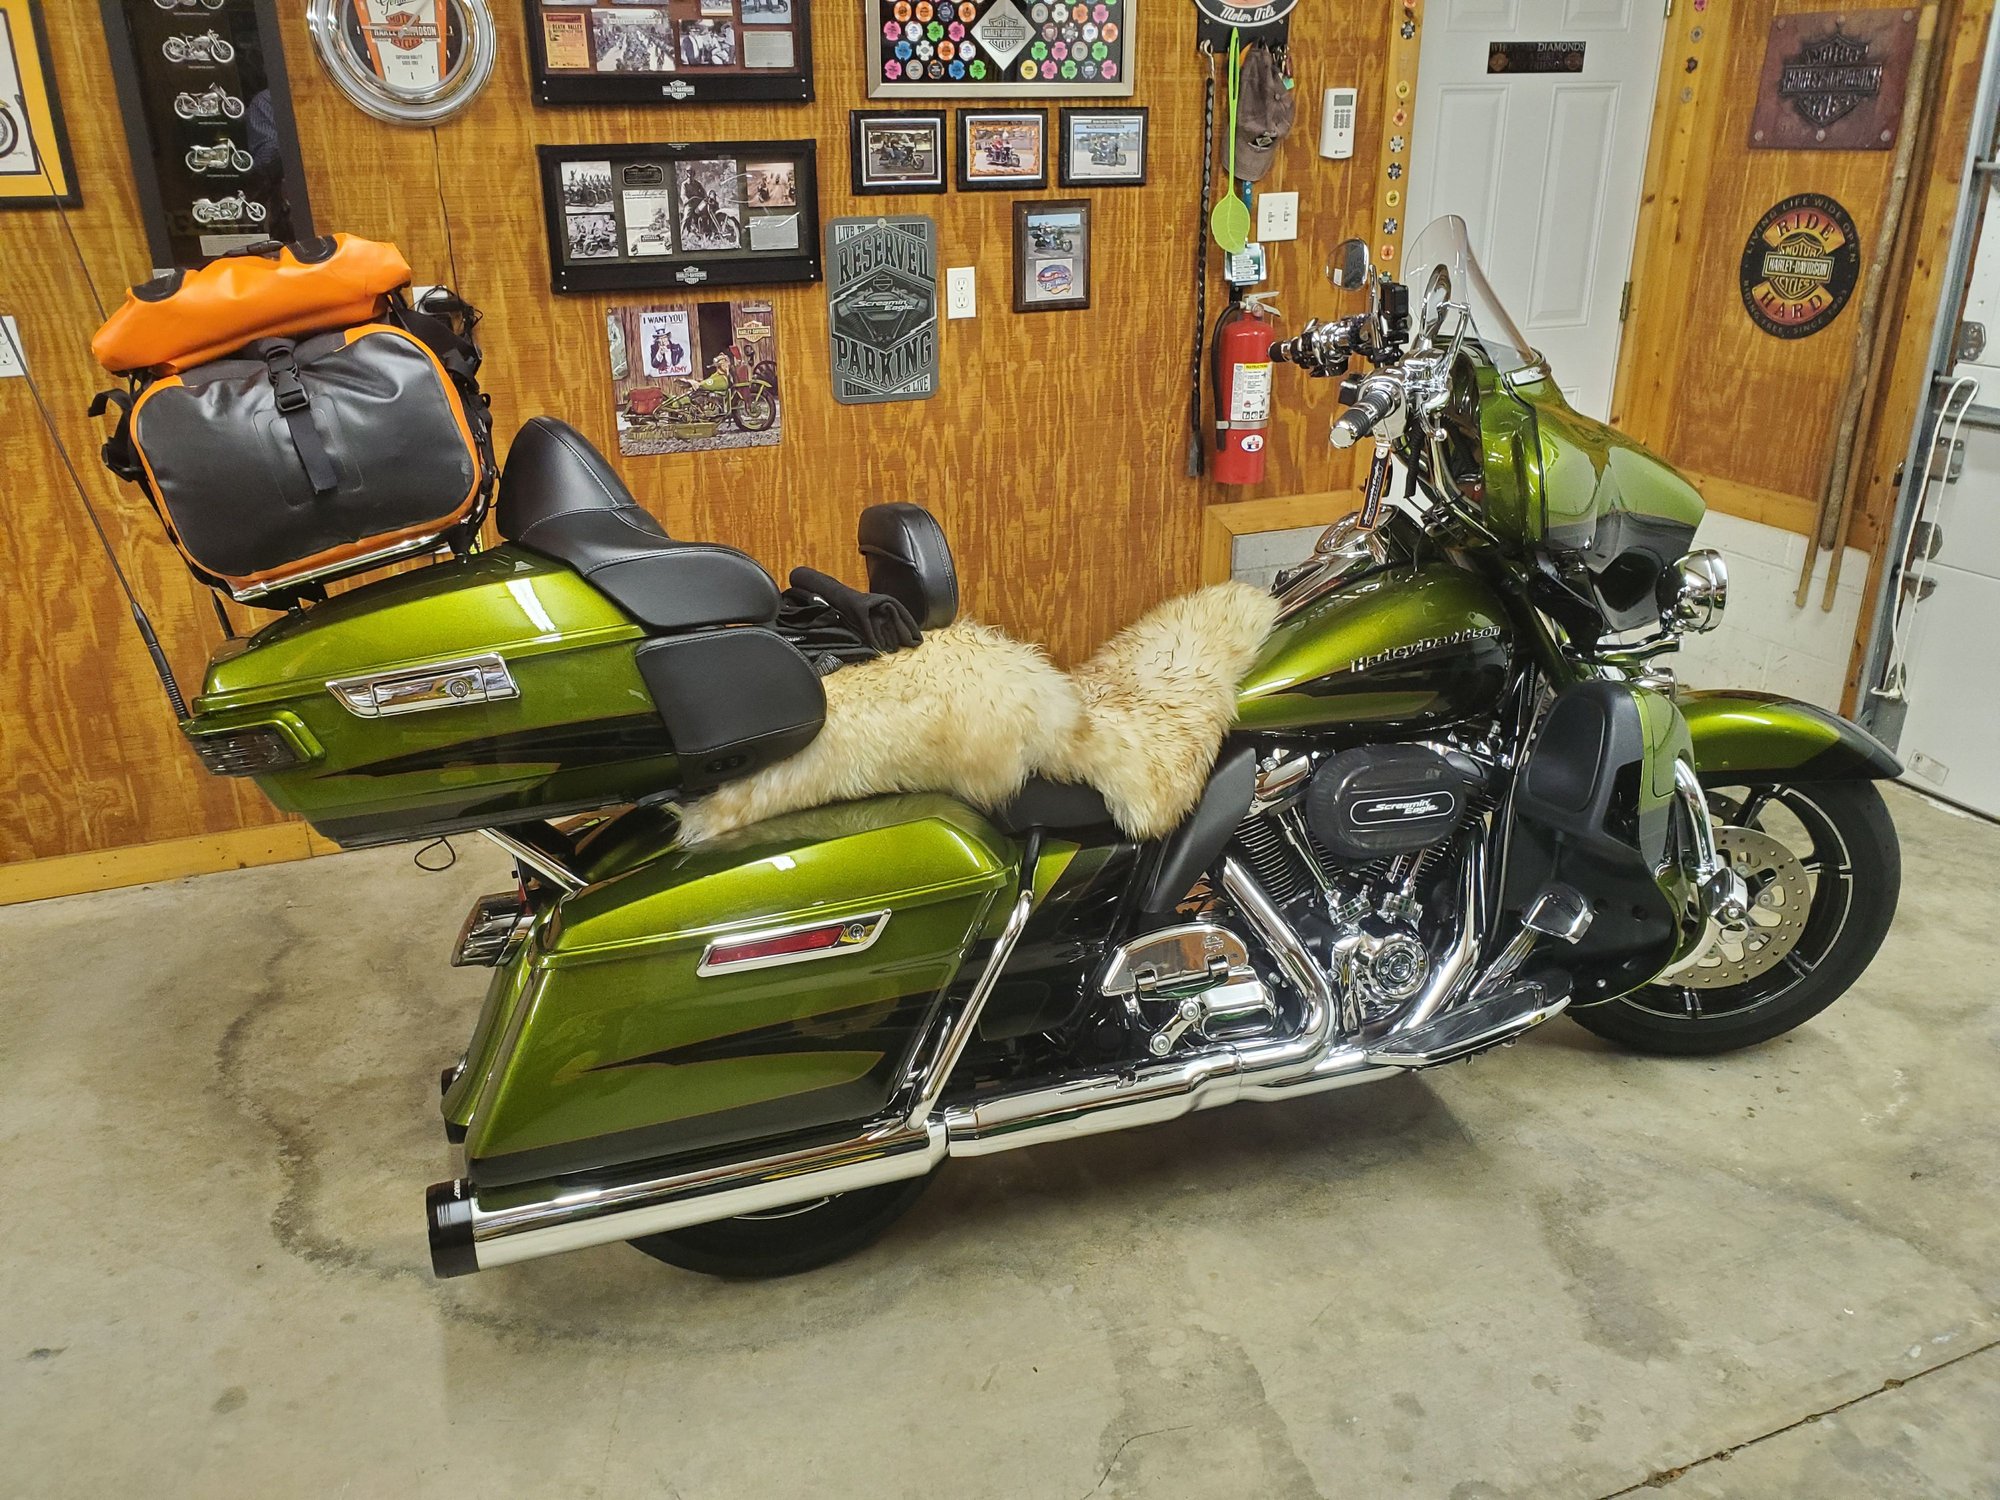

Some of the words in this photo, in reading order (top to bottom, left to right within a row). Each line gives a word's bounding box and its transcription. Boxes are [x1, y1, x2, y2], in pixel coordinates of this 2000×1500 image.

[1220, 5, 1253, 22] Motor
[1254, 5, 1276, 20] Oils
[1537, 42, 1585, 52] DIAMONDS
[838, 226, 854, 242] LIVE
[1776, 213, 1835, 241] RIDE
[838, 231, 928, 287] RESERVED
[1768, 258, 1829, 276] HARLEY-DAVIDSON
[1779, 276, 1811, 294] CYCLES
[884, 303, 915, 311] Eagle
[1759, 290, 1822, 318] HARD
[648, 315, 668, 324] WANT
[669, 313, 684, 322] YOU
[832, 330, 932, 388] PARKING
[912, 376, 929, 392] LIVE
[1350, 624, 1501, 673] Harley-Davidson
[1403, 804, 1439, 815] Eagle
